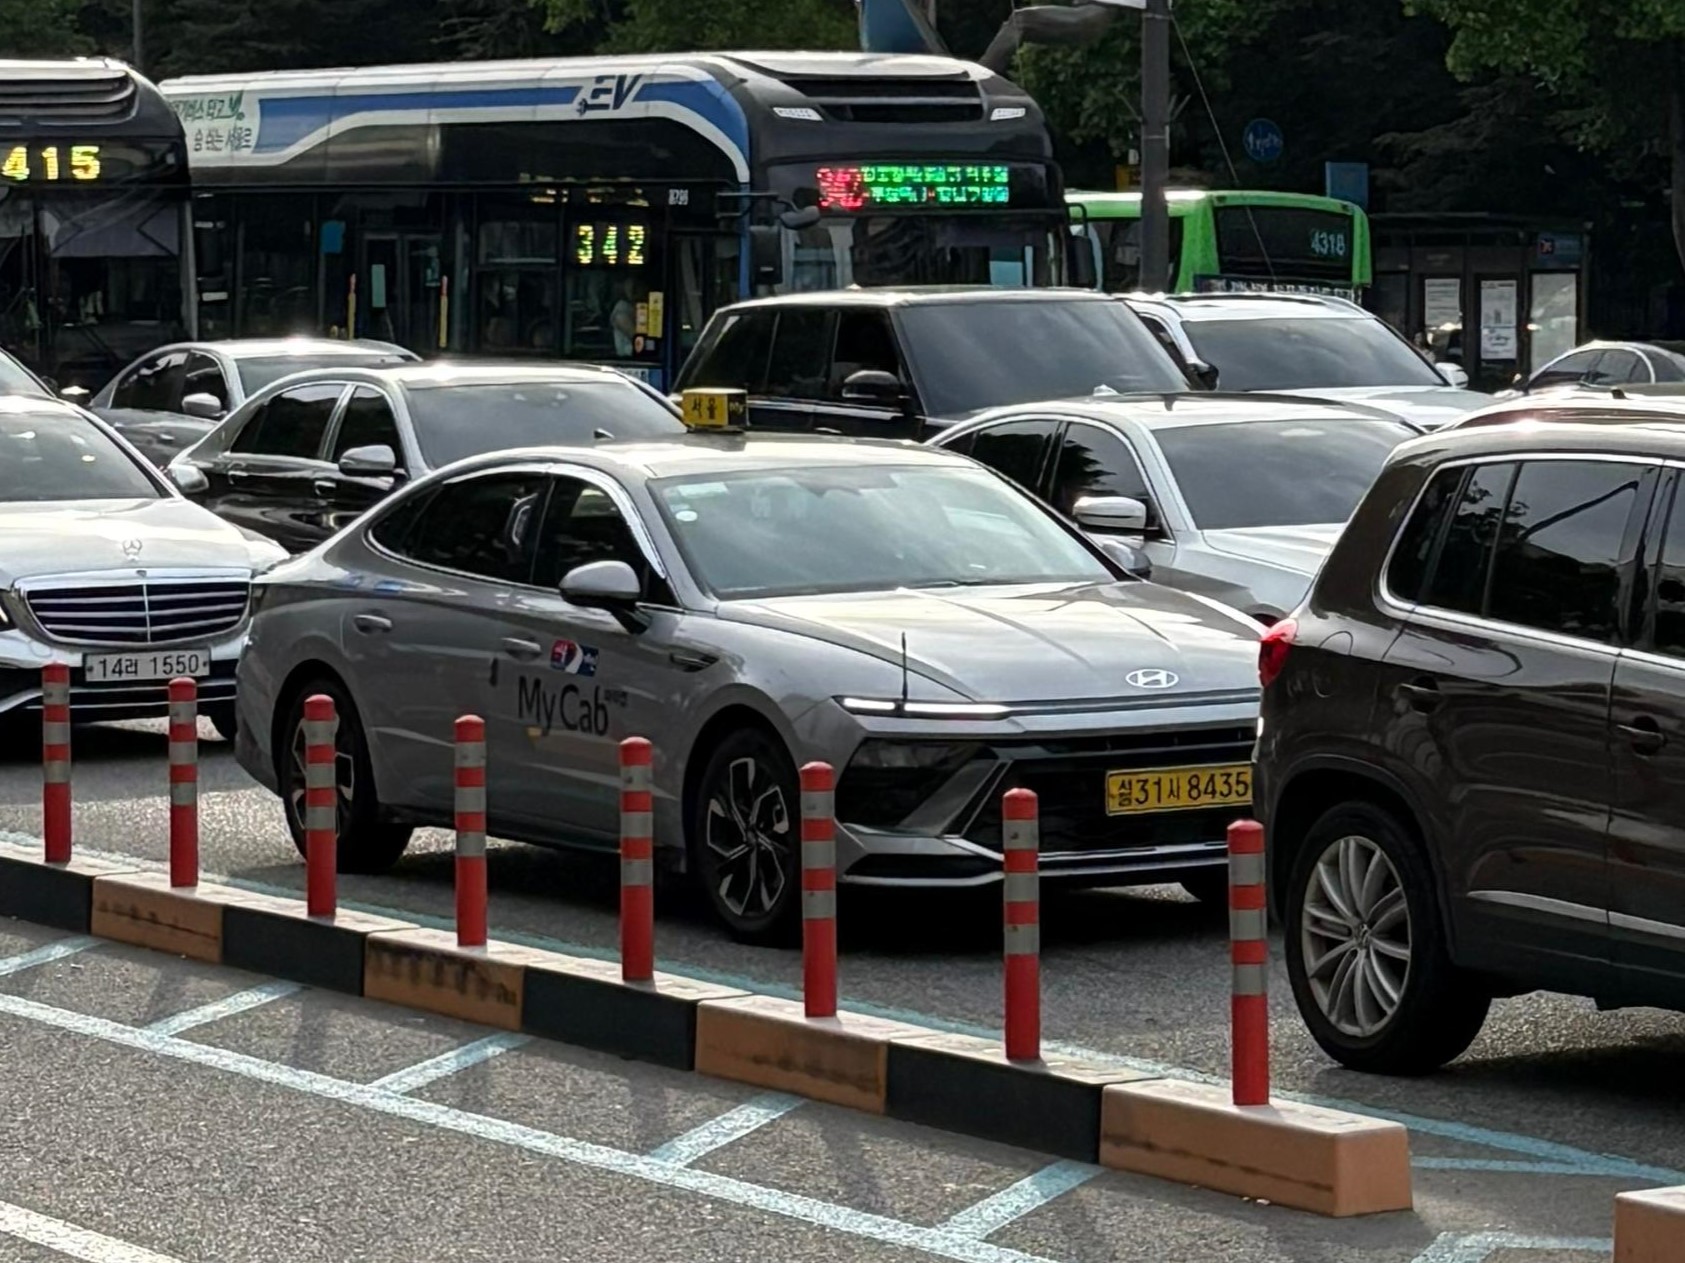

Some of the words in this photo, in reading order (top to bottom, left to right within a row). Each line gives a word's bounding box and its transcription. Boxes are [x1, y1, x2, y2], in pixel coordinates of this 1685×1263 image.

[576, 74, 644, 116] EV
[1, 146, 100, 181] 415
[577, 224, 645, 265] 342
[1311, 231, 1346, 255] 4318
[150, 653, 199, 676] 1550
[518, 675, 609, 737] MyCab
[1187, 771, 1250, 801] 8435
